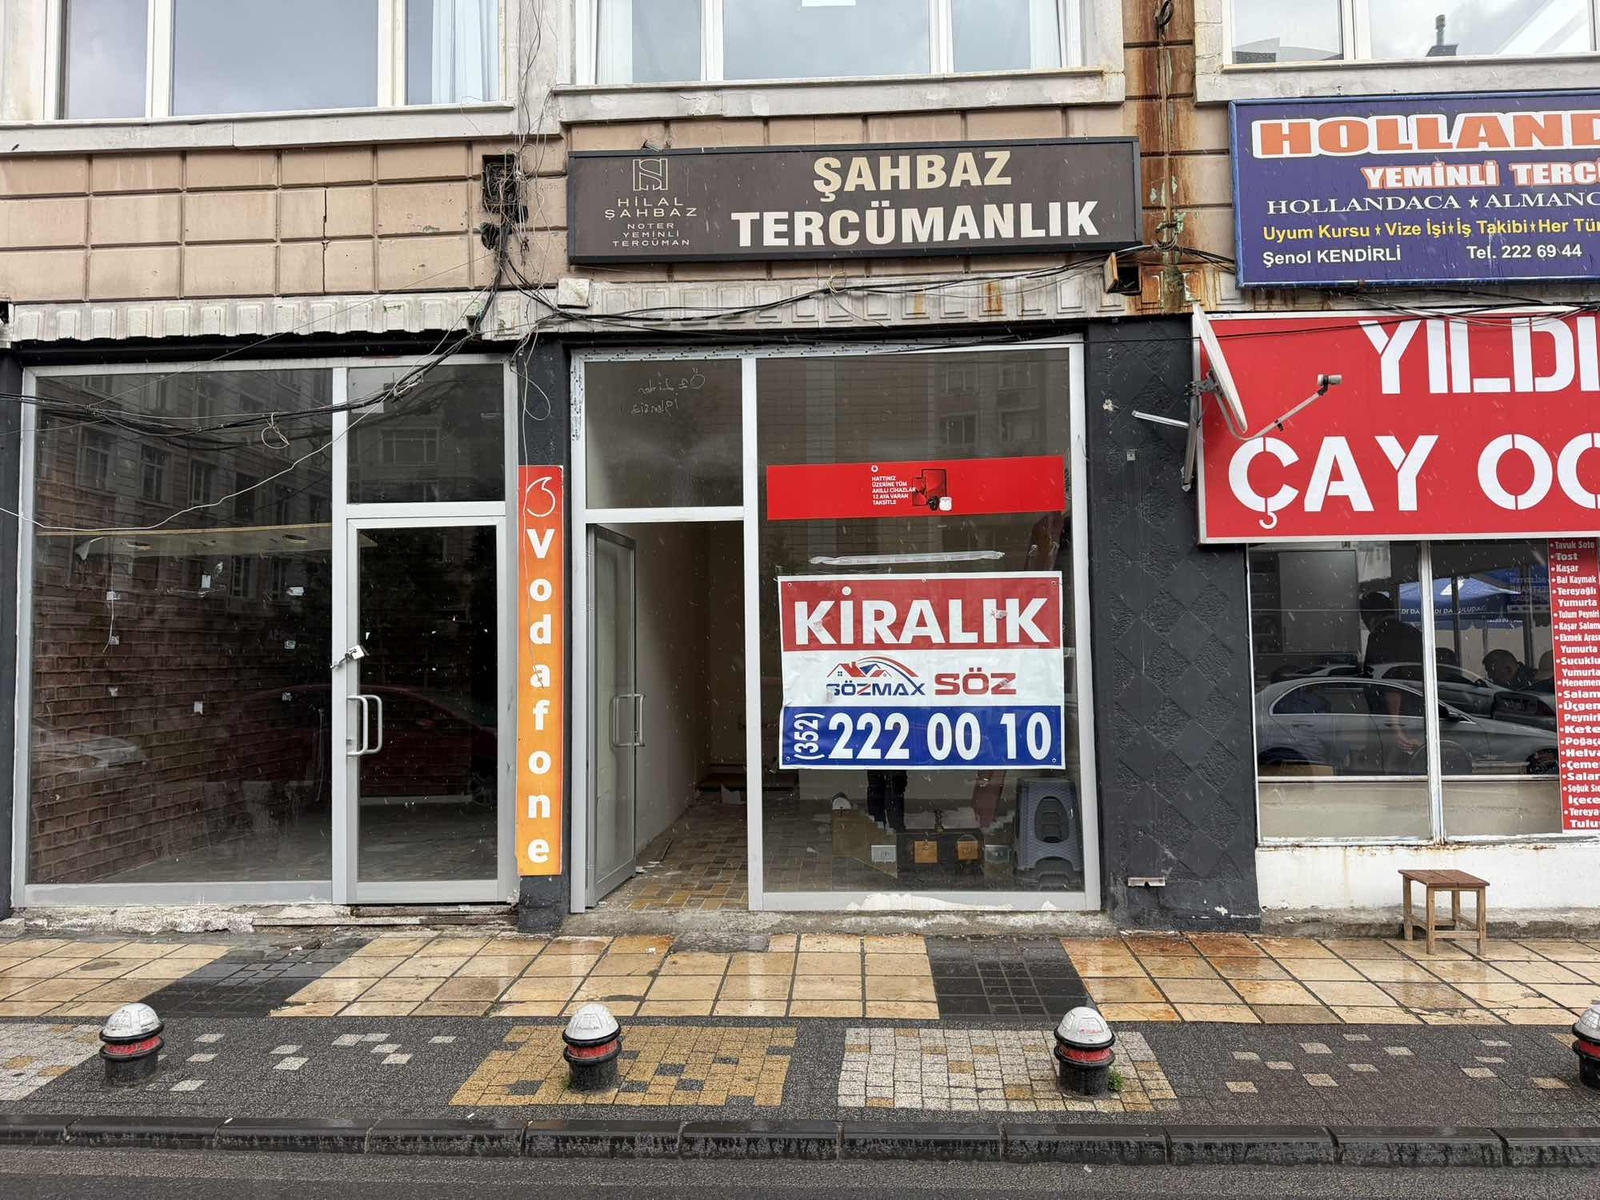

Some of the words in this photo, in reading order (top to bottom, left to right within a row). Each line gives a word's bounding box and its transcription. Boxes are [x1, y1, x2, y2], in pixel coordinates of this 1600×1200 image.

[813, 150, 1012, 203] ŞAHBAZ
[1361, 160, 1501, 190] YEMİNLİ
[1509, 160, 1600, 186] TERC
[617, 196, 684, 208] HİLAL
[1267, 194, 1462, 215] HOLLANDACA
[604, 207, 697, 221] ŞAHBAZ
[627, 222, 674, 230] NOTER
[731, 200, 1099, 248] TERCÜMANLIK
[1263, 226, 1313, 243] Uyum
[1318, 221, 1370, 239] Kursu
[1384, 220, 1422, 236] Vize
[1426, 218, 1447, 239] İşi
[1456, 217, 1472, 238] İş
[1476, 219, 1528, 235] Takibi
[1538, 219, 1569, 233] Her
[622, 230, 679, 239] YEMİNLİ
[612, 238, 690, 247] TERCÜMAN
[1263, 251, 1311, 268] Şenol
[1317, 245, 1401, 263] KENDİRLİ
[1466, 245, 1497, 260] Tel.
[1501, 245, 1532, 259] 222
[1537, 244, 1557, 259] 69
[1561, 244, 1582, 258] 44
[1228, 434, 1440, 530] ÇAY
[1555, 552, 1578, 560] Tost
[1556, 564, 1579, 574] Kaşar
[1558, 599, 1598, 607] Yumurta
[794, 585, 1050, 645] KİRALIK
[1561, 645, 1598, 653] Yumurta
[934, 667, 1017, 696] SÖZ
[794, 712, 825, 760] (352)
[828, 712, 910, 760] 222
[927, 712, 981, 761] 00
[1000, 712, 1052, 761] 10
[1567, 760, 1600, 770] Çeme
[1570, 819, 1600, 828] Tulu
